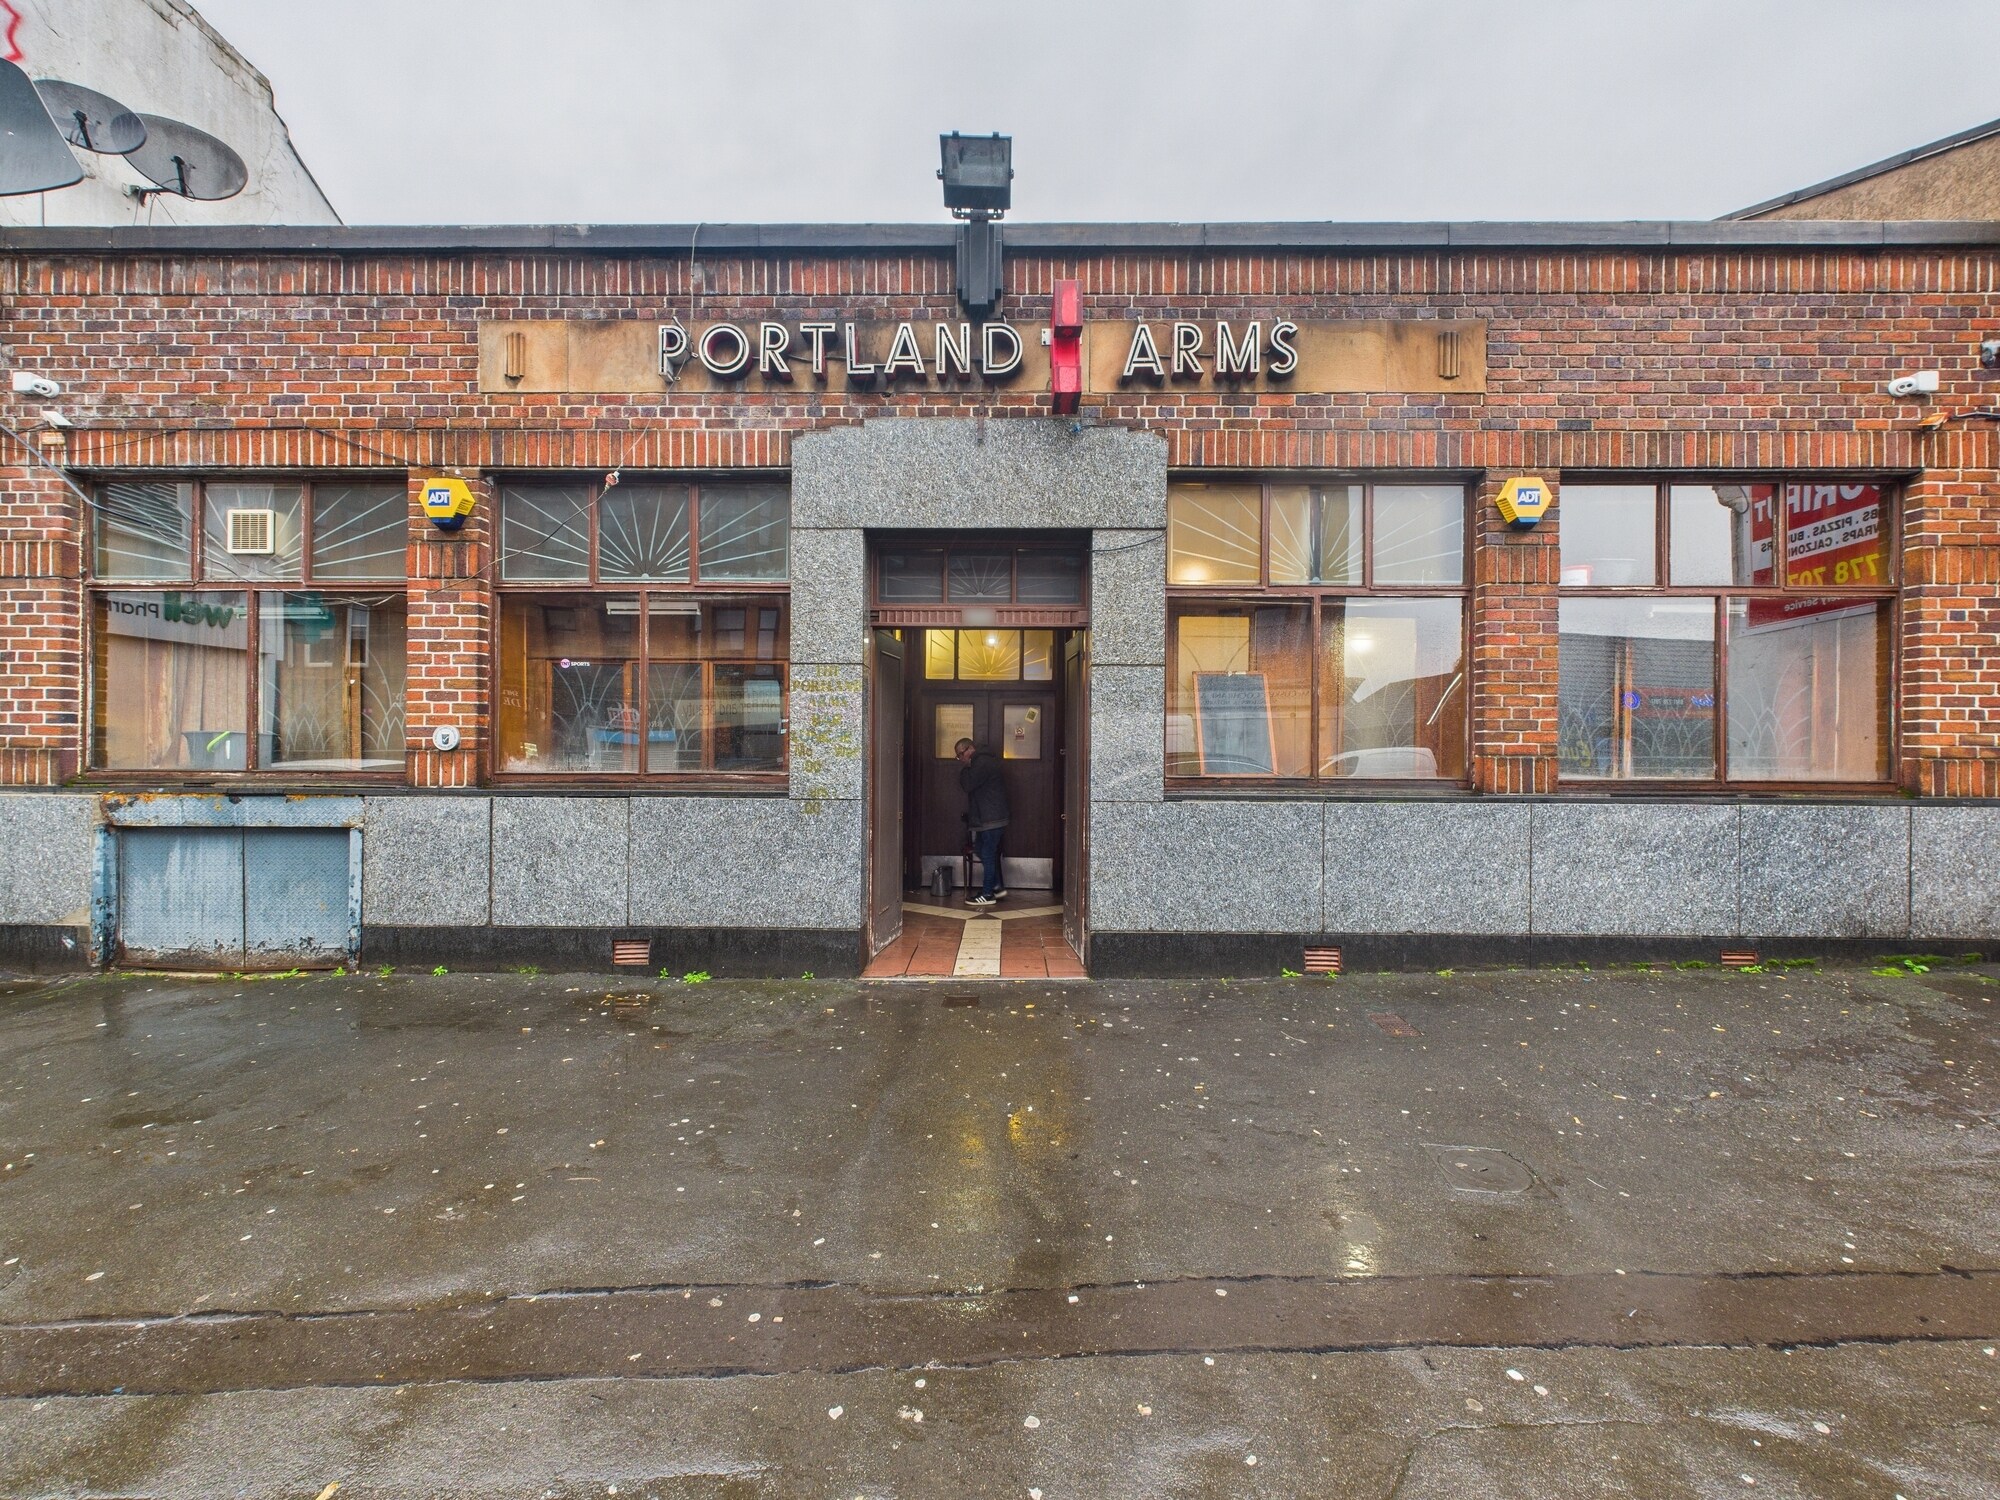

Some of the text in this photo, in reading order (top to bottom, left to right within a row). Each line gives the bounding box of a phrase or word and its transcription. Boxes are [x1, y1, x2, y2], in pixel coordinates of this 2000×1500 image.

[658, 321, 1299, 379] PORTLAND ARMS
[428, 490, 451, 504] ADT
[1516, 490, 1541, 503] ADT
